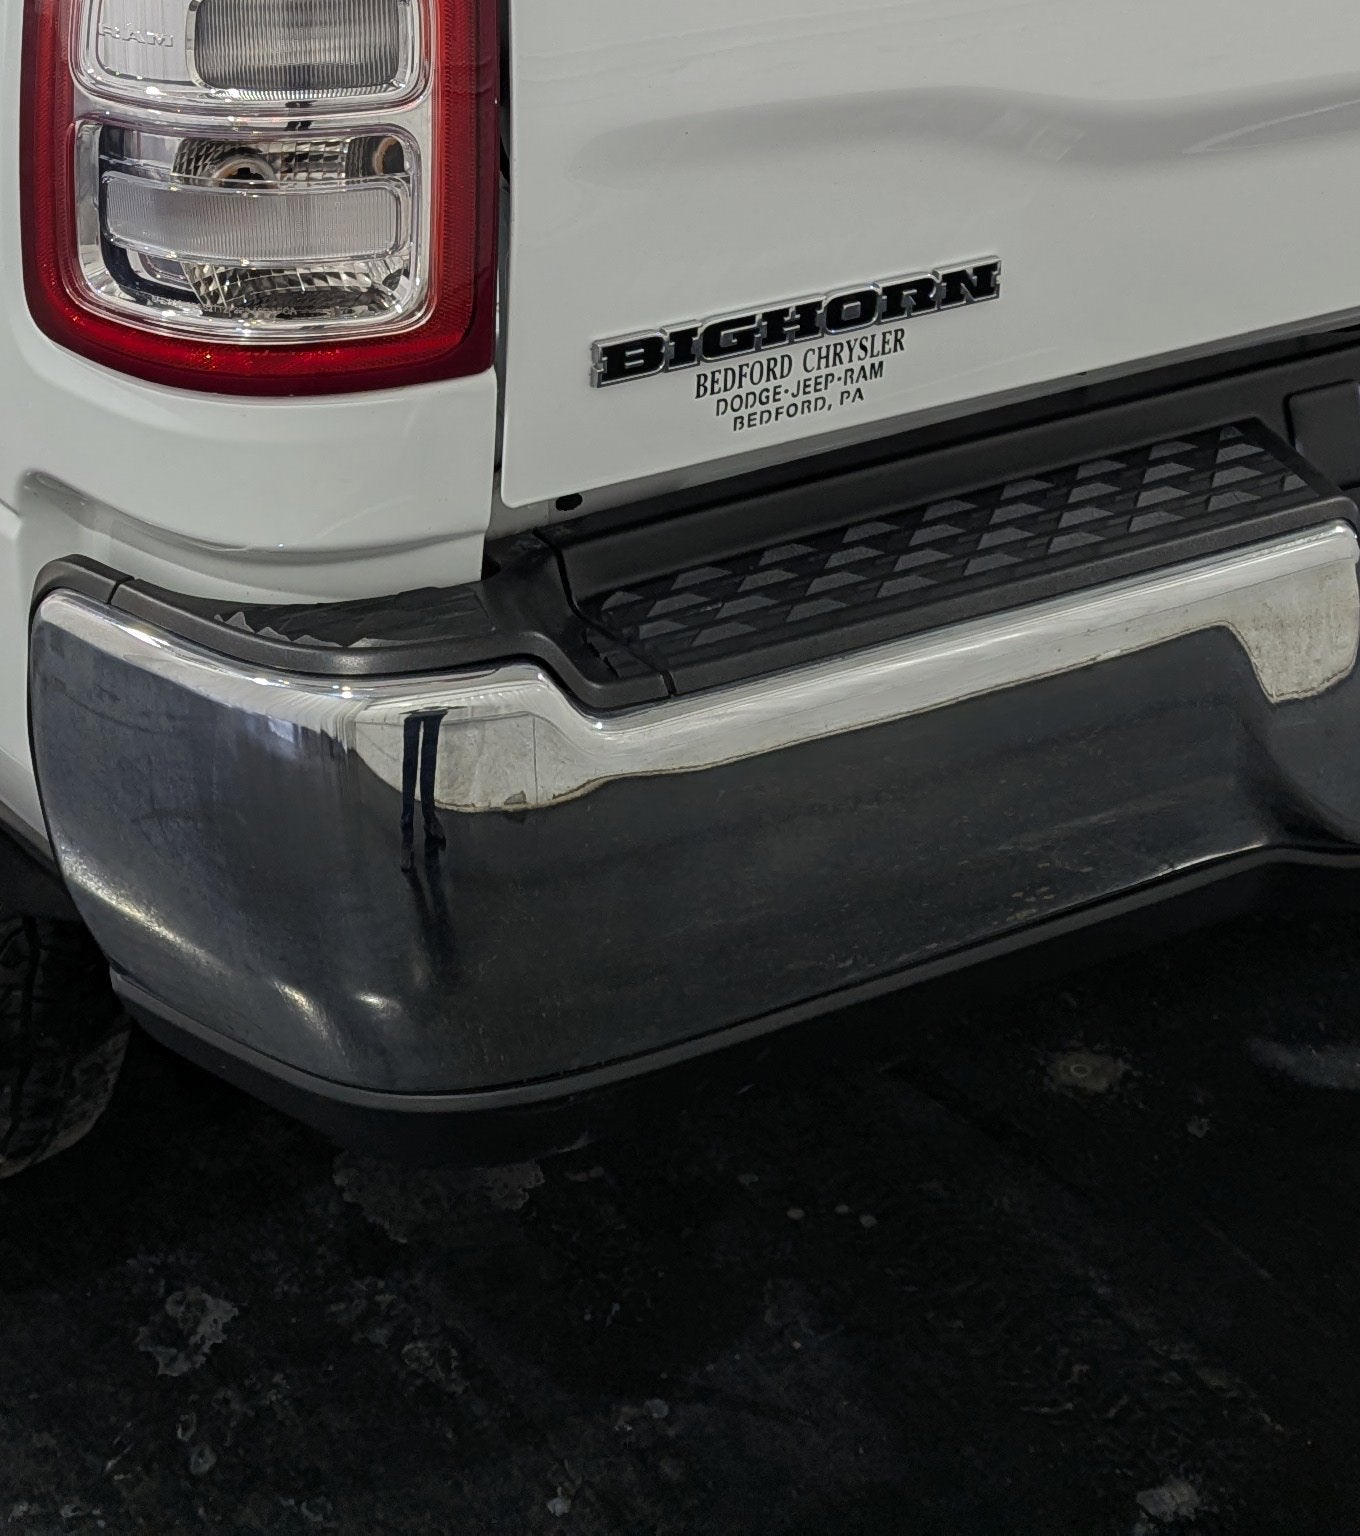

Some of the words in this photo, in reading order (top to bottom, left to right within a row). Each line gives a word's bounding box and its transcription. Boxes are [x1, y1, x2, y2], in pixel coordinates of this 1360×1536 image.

[590, 255, 1003, 388] BIGHORN
[695, 353, 793, 399] BEDFORD
[802, 327, 906, 373] CHRYSLER
[733, 396, 833, 432] BEDFORD,
[839, 387, 865, 406] PA
